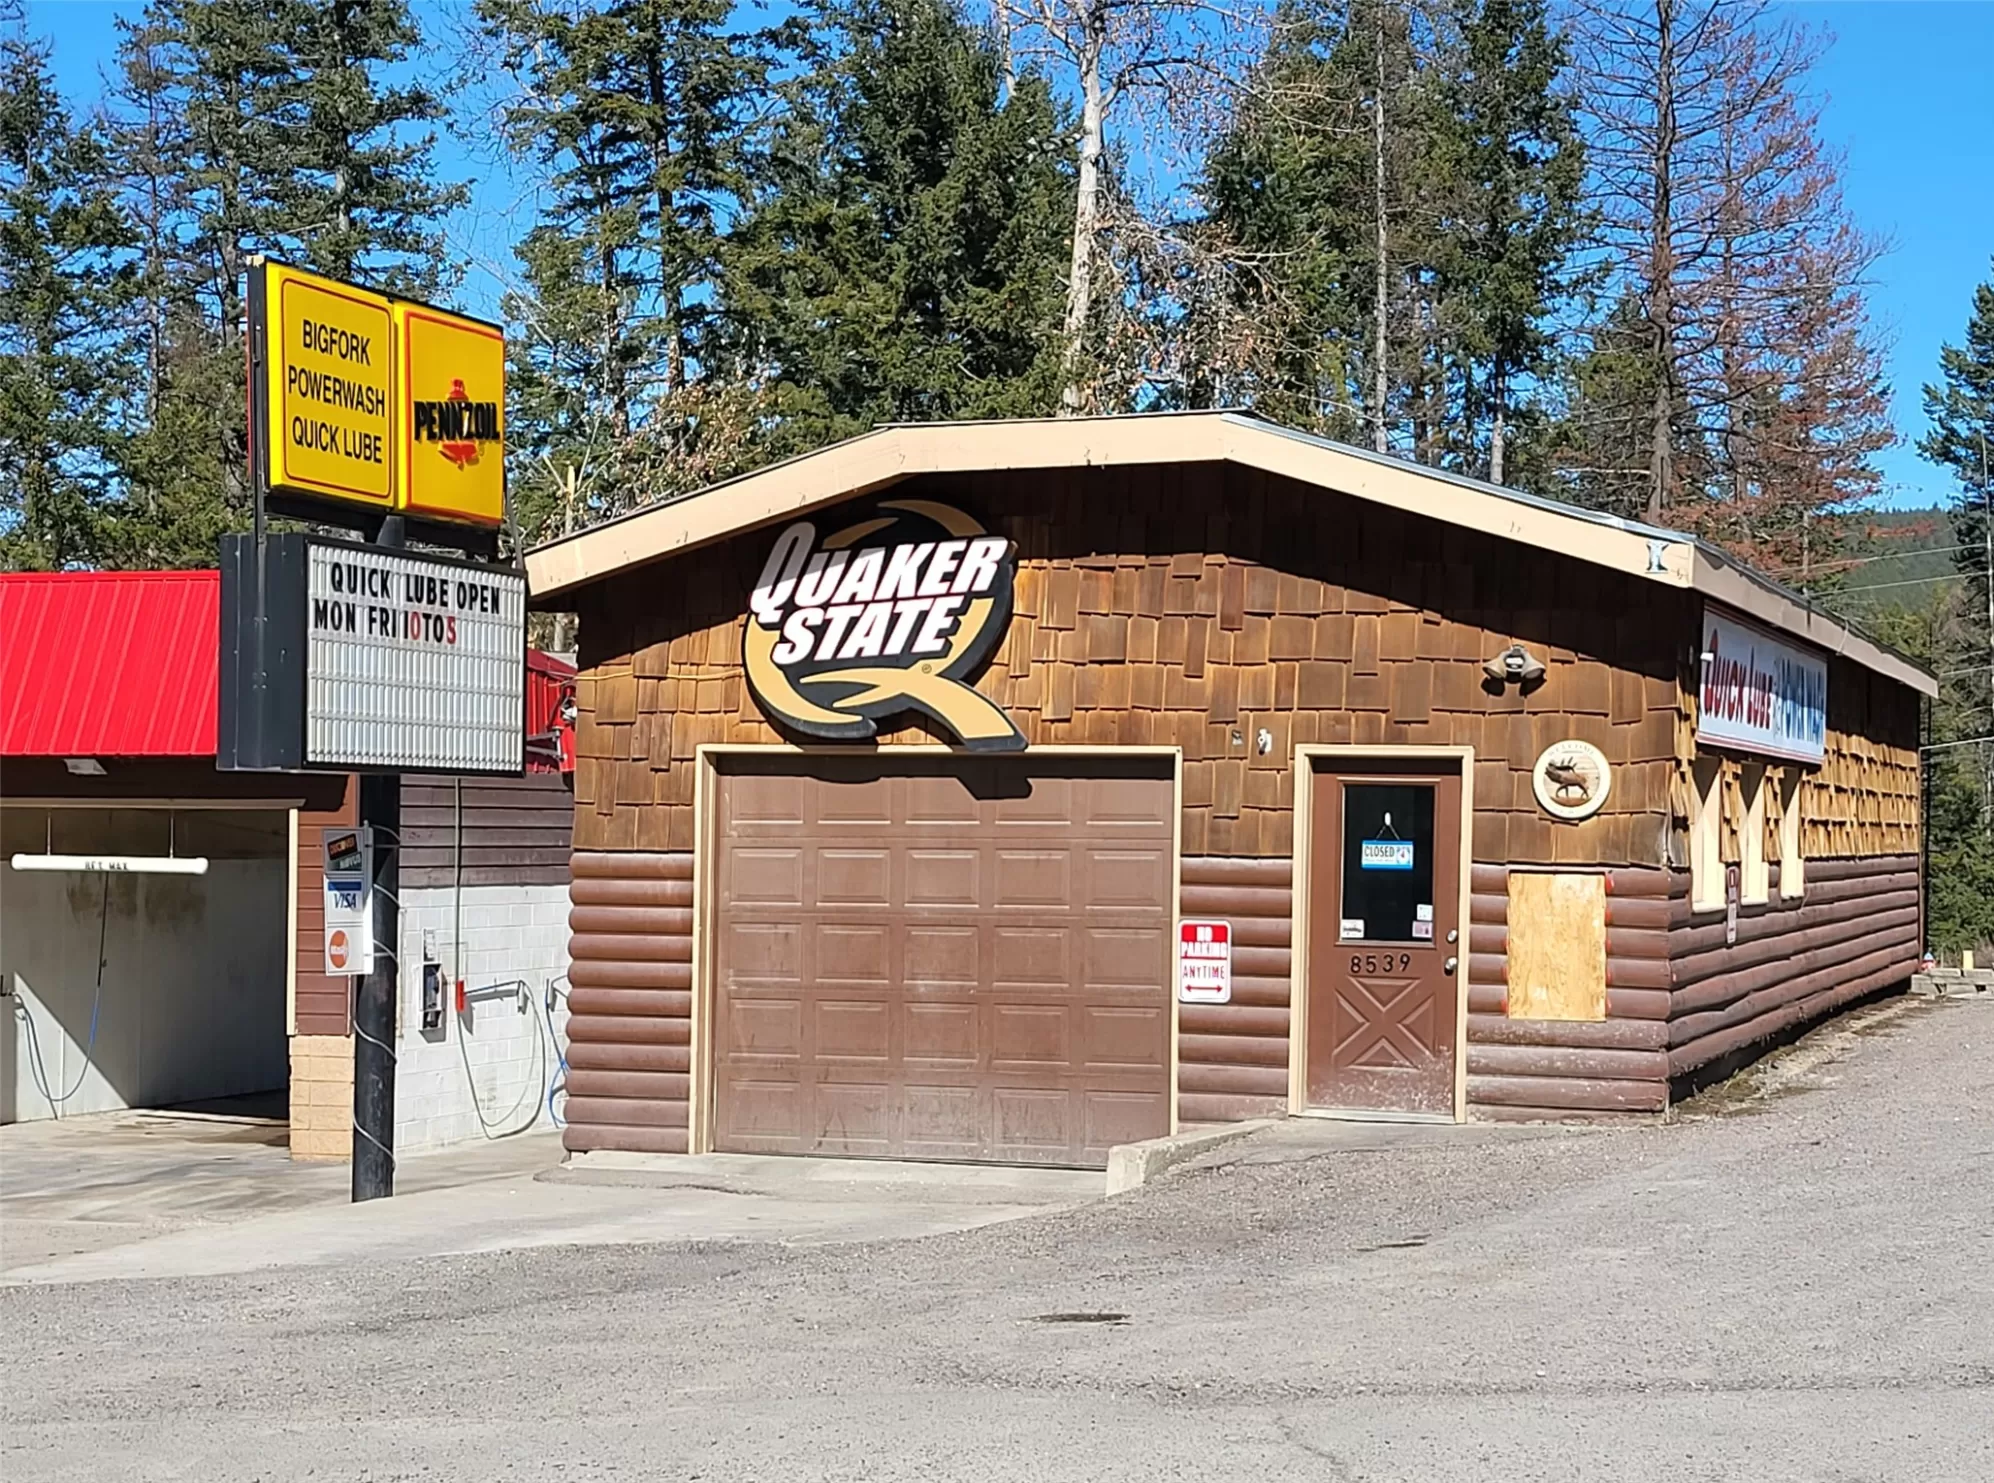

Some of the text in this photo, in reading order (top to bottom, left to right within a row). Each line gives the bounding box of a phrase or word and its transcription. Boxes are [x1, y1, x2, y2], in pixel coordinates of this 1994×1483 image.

[302, 318, 371, 366] BIGFORK
[288, 364, 385, 417] POWERWASH
[292, 415, 383, 464] QUICK LUBE
[414, 401, 501, 442] PENNZOIL
[331, 562, 501, 615] QUICK LUBE OPEN
[750, 521, 1009, 624] QUAKER
[314, 598, 357, 634] MON
[368, 607, 397, 639] FRI
[771, 595, 965, 665] STATE
[1704, 628, 1747, 723] QUICK
[1747, 646, 1773, 730] LUBE
[1364, 846, 1395, 857] CLOSED
[333, 892, 357, 909] VISA
[1182, 965, 1225, 979] ANYTIME
[1350, 953, 1411, 974] 8539
